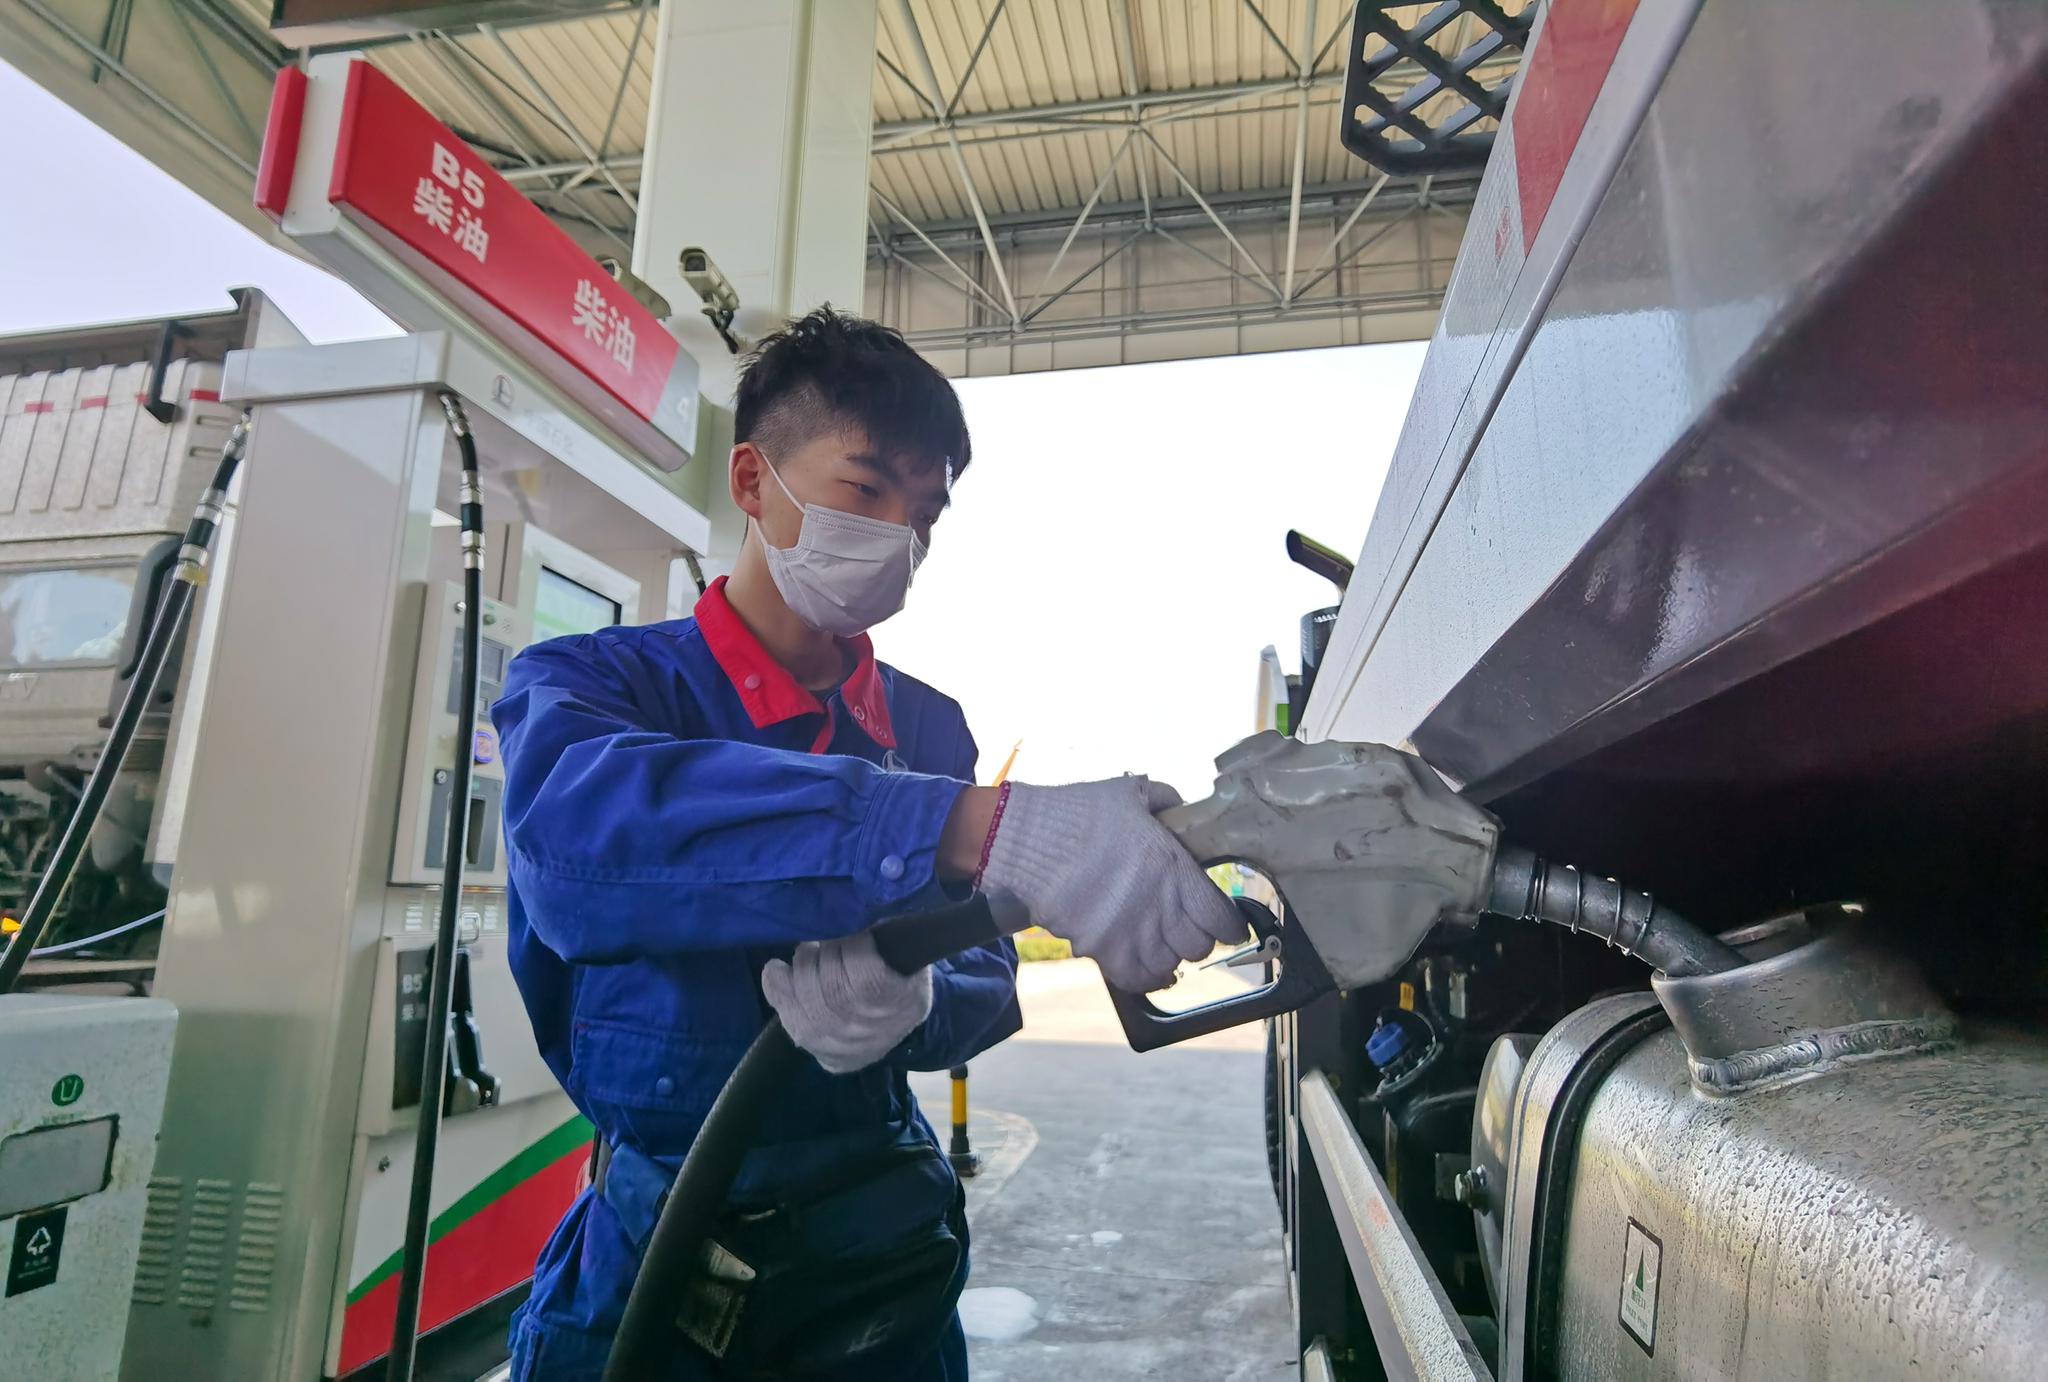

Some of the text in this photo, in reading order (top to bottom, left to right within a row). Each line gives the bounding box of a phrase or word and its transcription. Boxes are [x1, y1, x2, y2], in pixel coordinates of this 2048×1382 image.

[432, 141, 486, 209] B5
[412, 176, 489, 264] 柴油
[572, 279, 636, 374] 柴油
